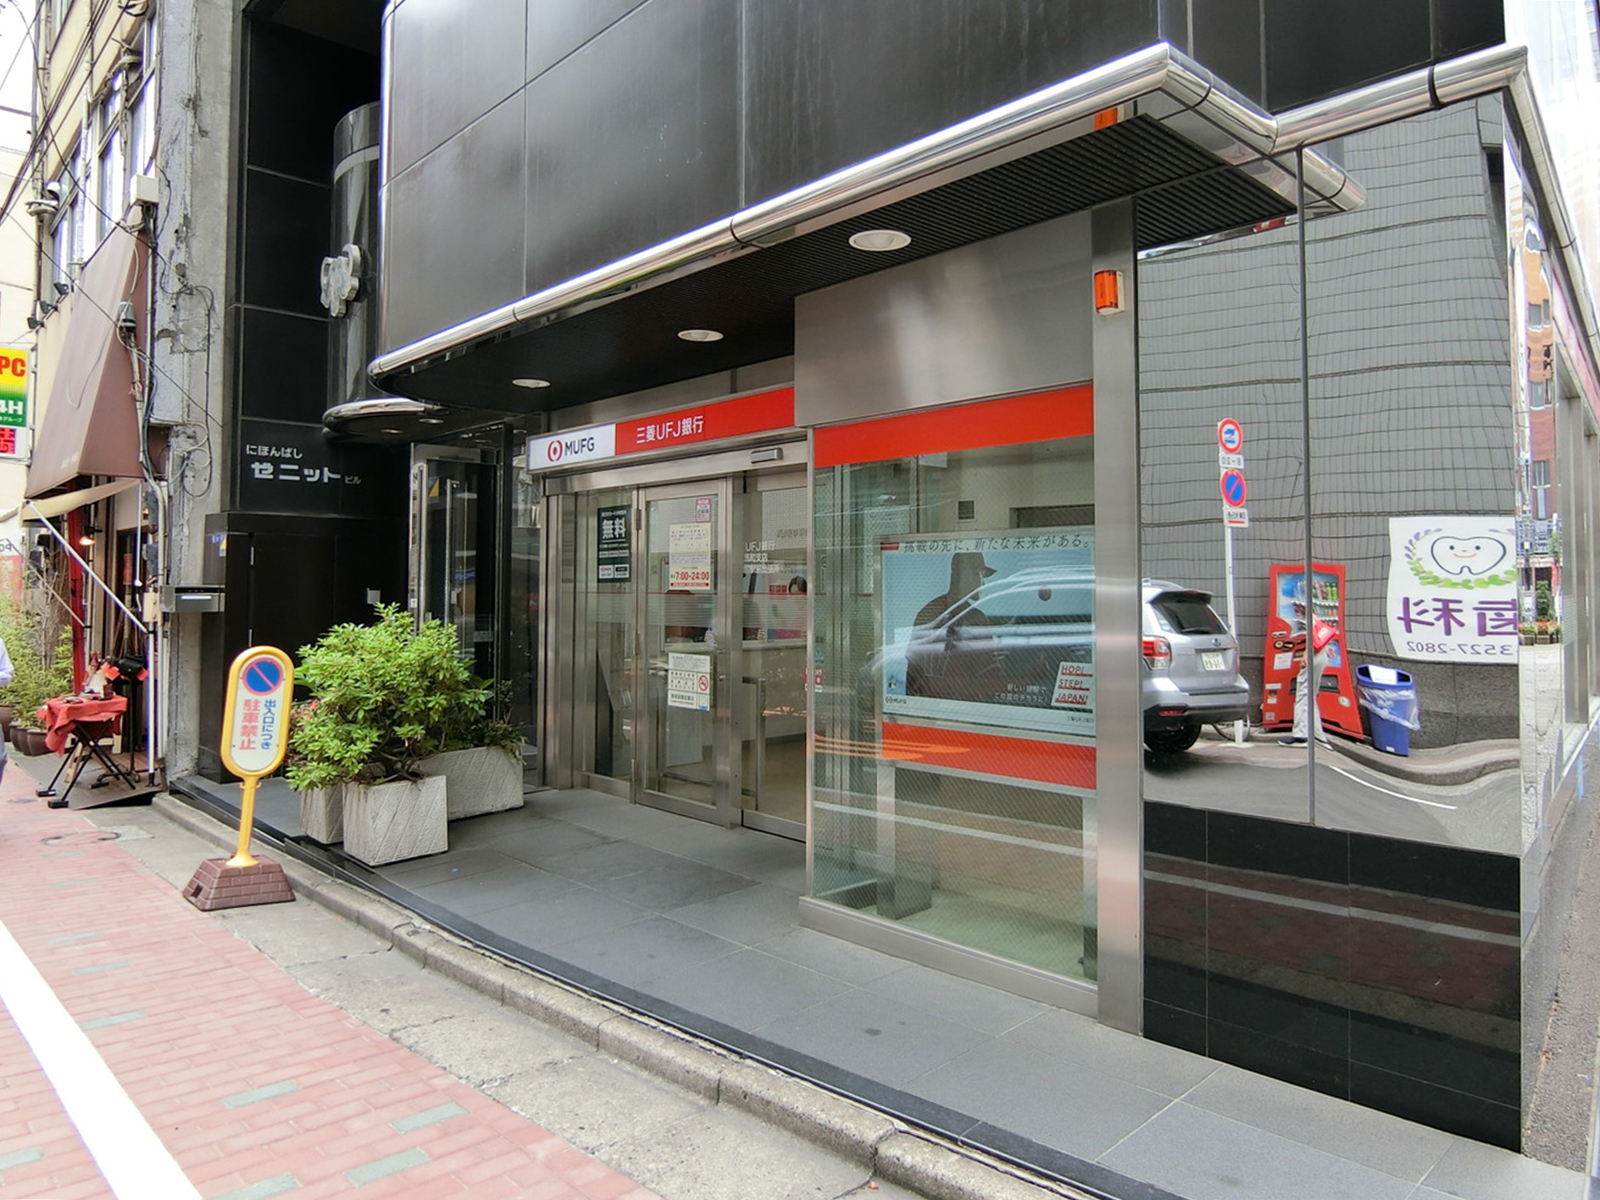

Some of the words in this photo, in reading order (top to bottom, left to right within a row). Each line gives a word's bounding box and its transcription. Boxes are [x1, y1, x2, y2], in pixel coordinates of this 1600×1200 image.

[0, 415, 23, 423] グループ
[635, 415, 704, 443] 三菱UFJ銀行
[246, 444, 303, 459] にほんばし
[565, 436, 595, 456] MUFG
[602, 517, 626, 539] 無料
[903, 534, 1090, 553] 挑戦の先に、新たな未来がある。
[1061, 665, 1085, 674] HOP!
[1058, 679, 1083, 688] STEP!
[1056, 693, 1089, 704] JAPAN!
[238, 698, 262, 751] 駐車禁止
[260, 698, 277, 750] 出入口につき
